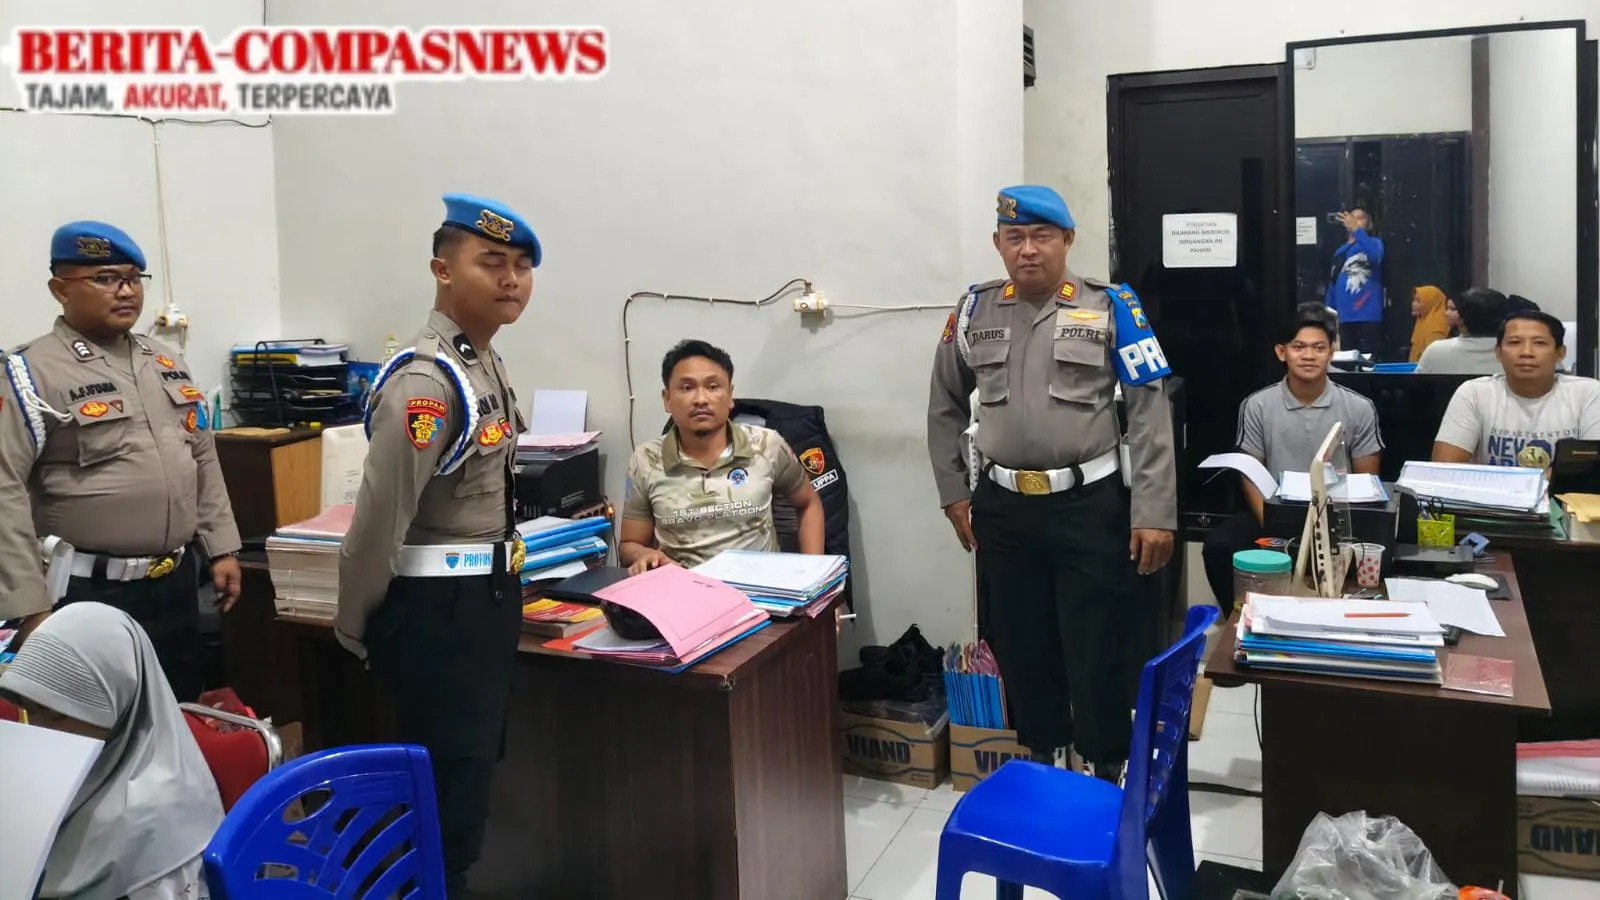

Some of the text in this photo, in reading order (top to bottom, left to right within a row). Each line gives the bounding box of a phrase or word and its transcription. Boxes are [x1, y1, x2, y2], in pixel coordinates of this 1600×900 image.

[972, 329, 1005, 341] DARUS
[1061, 328, 1101, 342] POLRI
[1118, 336, 1169, 380] PR
[410, 399, 445, 413] PROPAM
[673, 500, 752, 519] 1ST SECTION
[846, 733, 911, 764] VIAND
